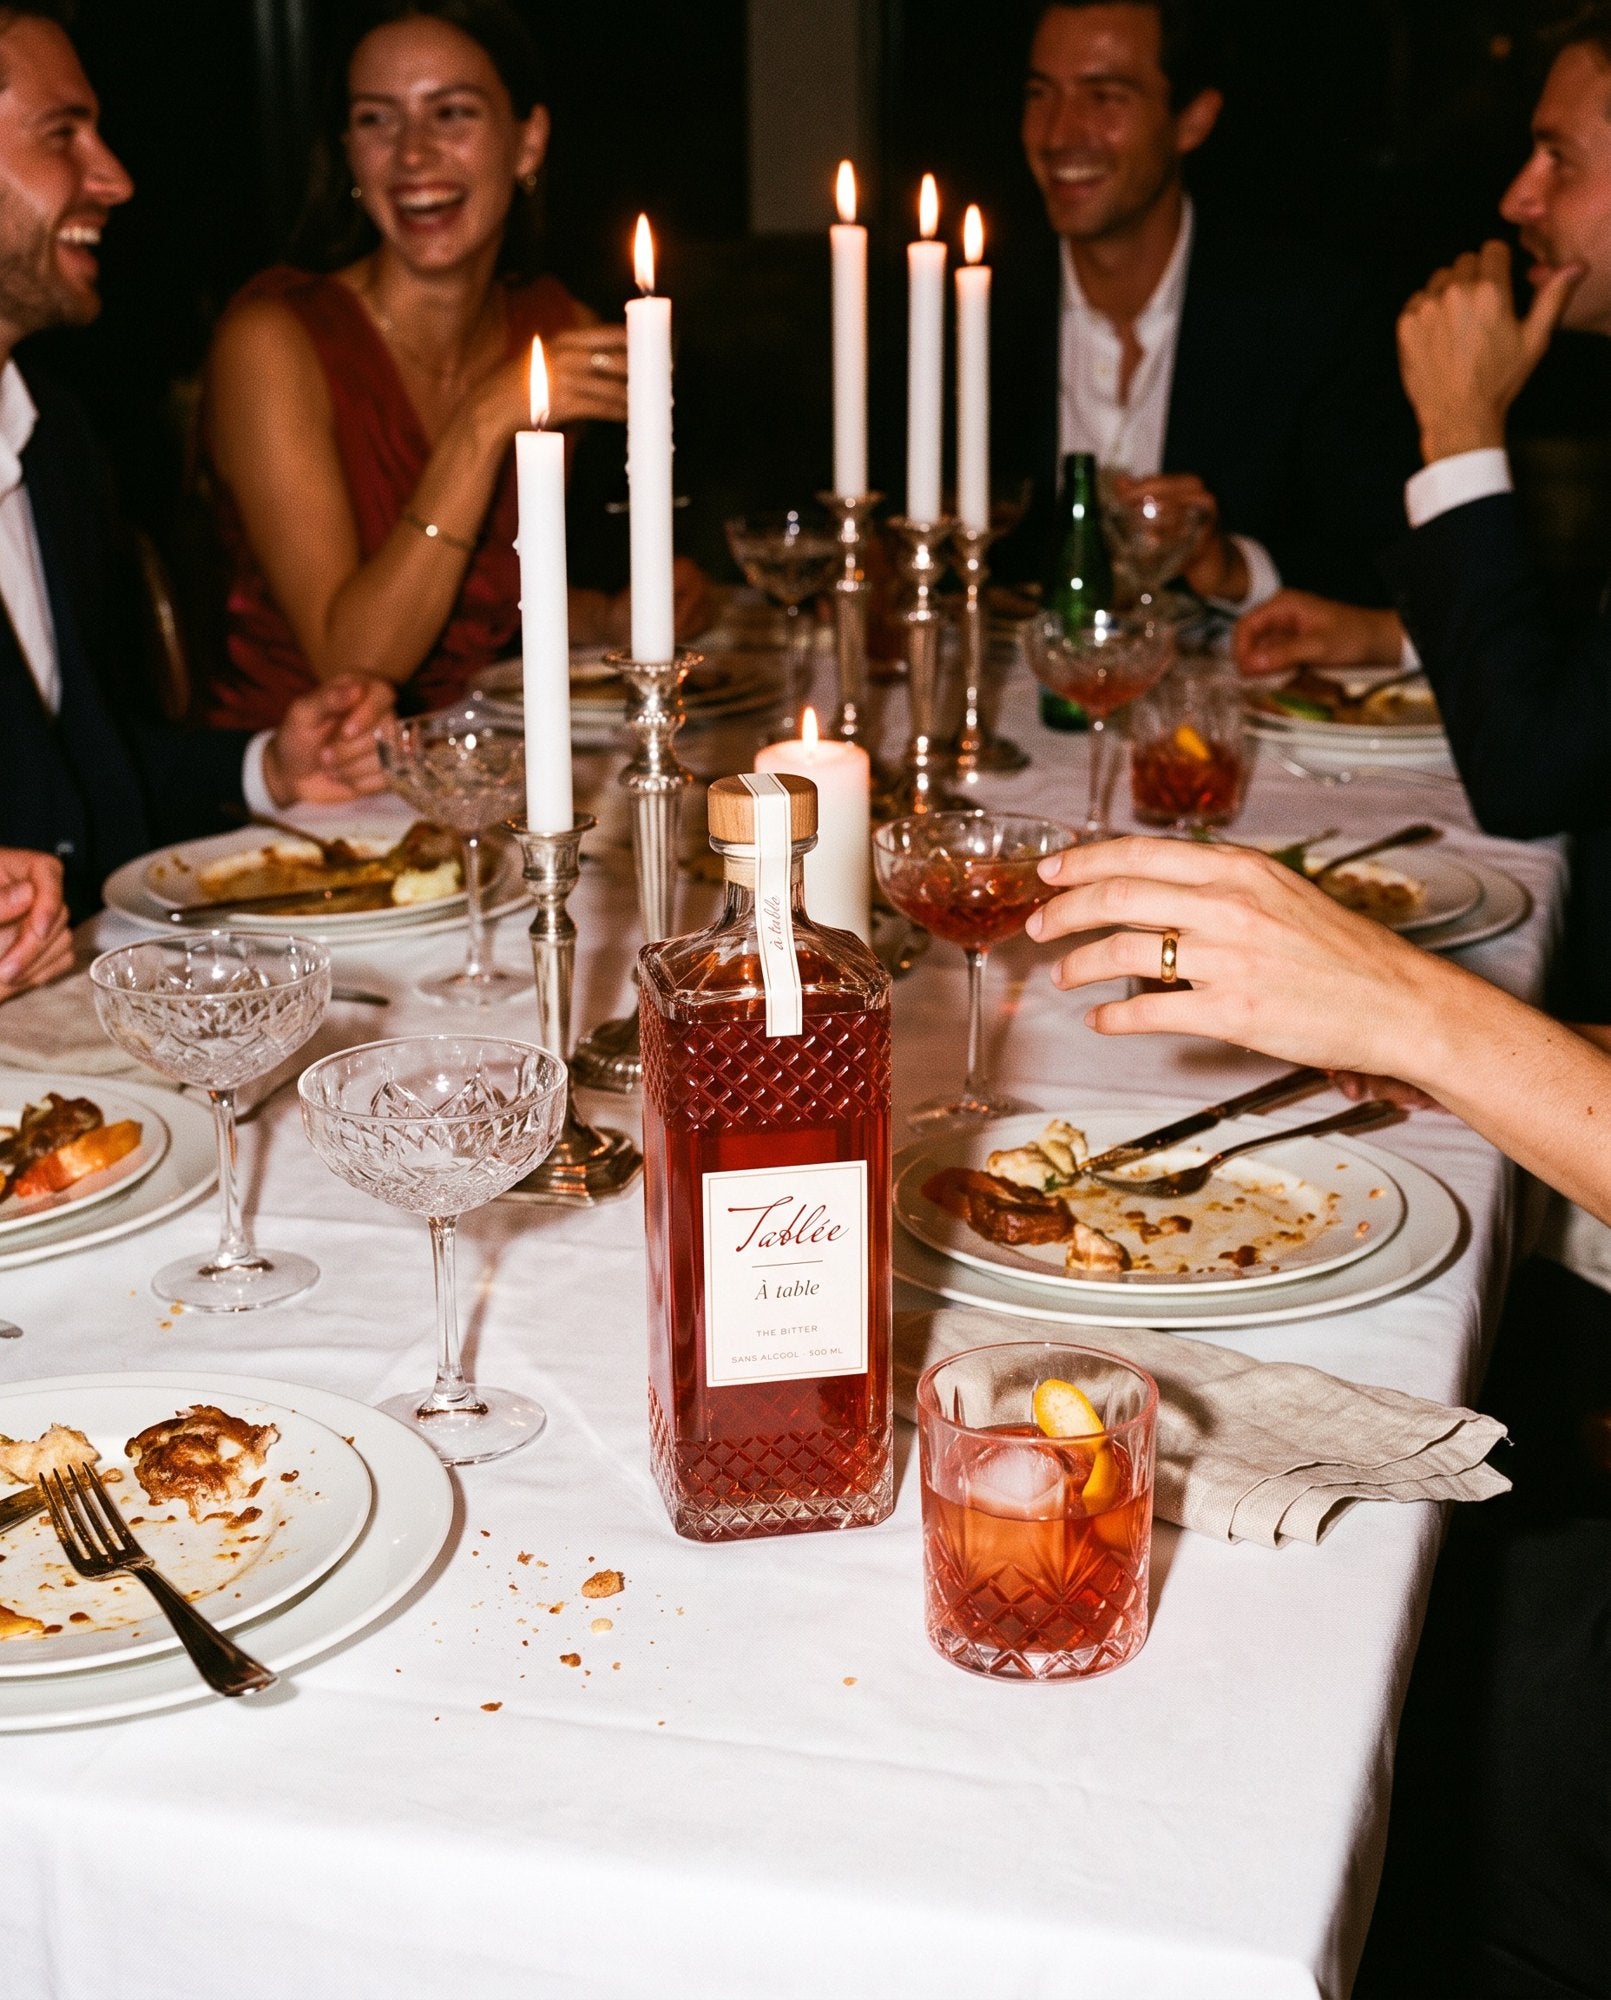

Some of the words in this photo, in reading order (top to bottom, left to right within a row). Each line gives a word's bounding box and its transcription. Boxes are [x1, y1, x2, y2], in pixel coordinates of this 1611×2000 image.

[763, 895, 782, 934] table
[728, 1195, 850, 1252] Tablée
[754, 1279, 769, 1301] À
[776, 1279, 820, 1299] table
[756, 1329, 777, 1338] THE
[780, 1325, 818, 1336] BITTER
[731, 1355, 758, 1364] SANS
[809, 1349, 828, 1357] 500
[830, 1347, 843, 1355] ML
